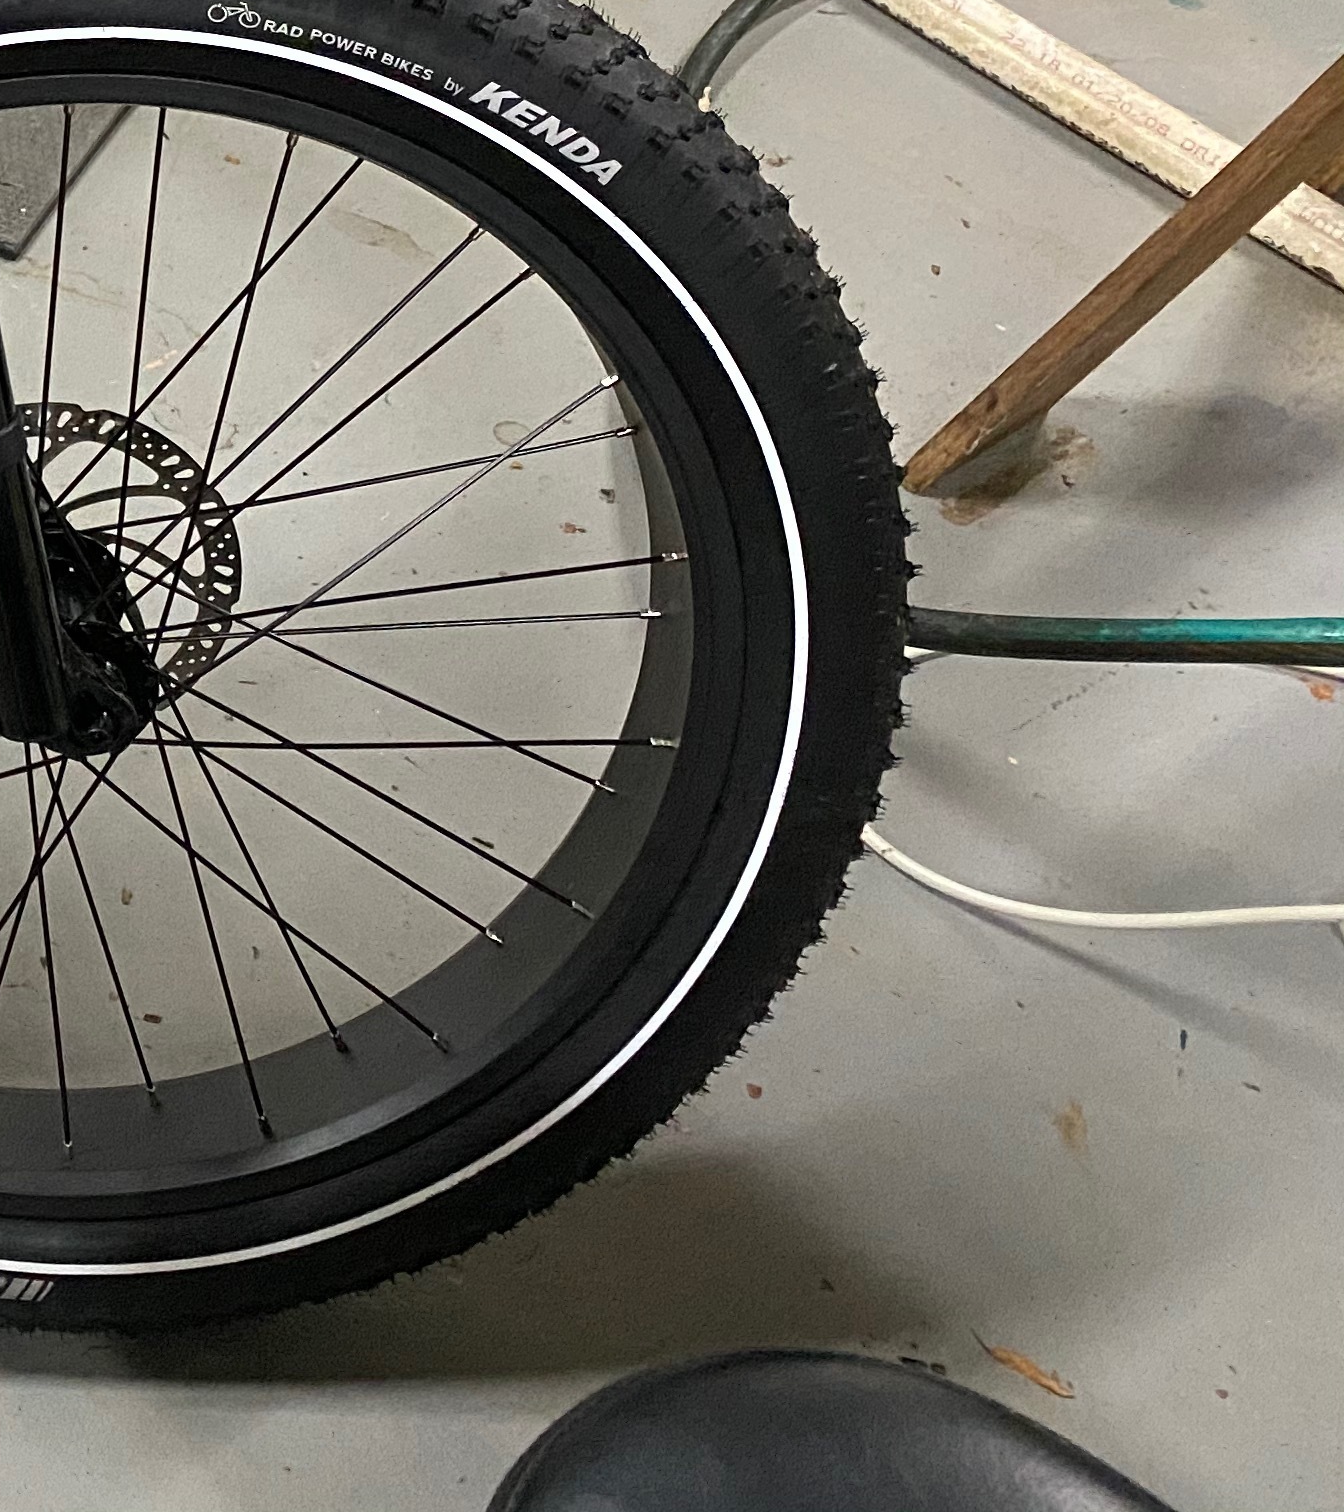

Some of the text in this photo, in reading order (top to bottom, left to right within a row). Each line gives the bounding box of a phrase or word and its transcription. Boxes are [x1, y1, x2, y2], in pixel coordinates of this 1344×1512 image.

[262, 18, 465, 97] RAD POWER BIKES by
[468, 81, 623, 186] KENDA
